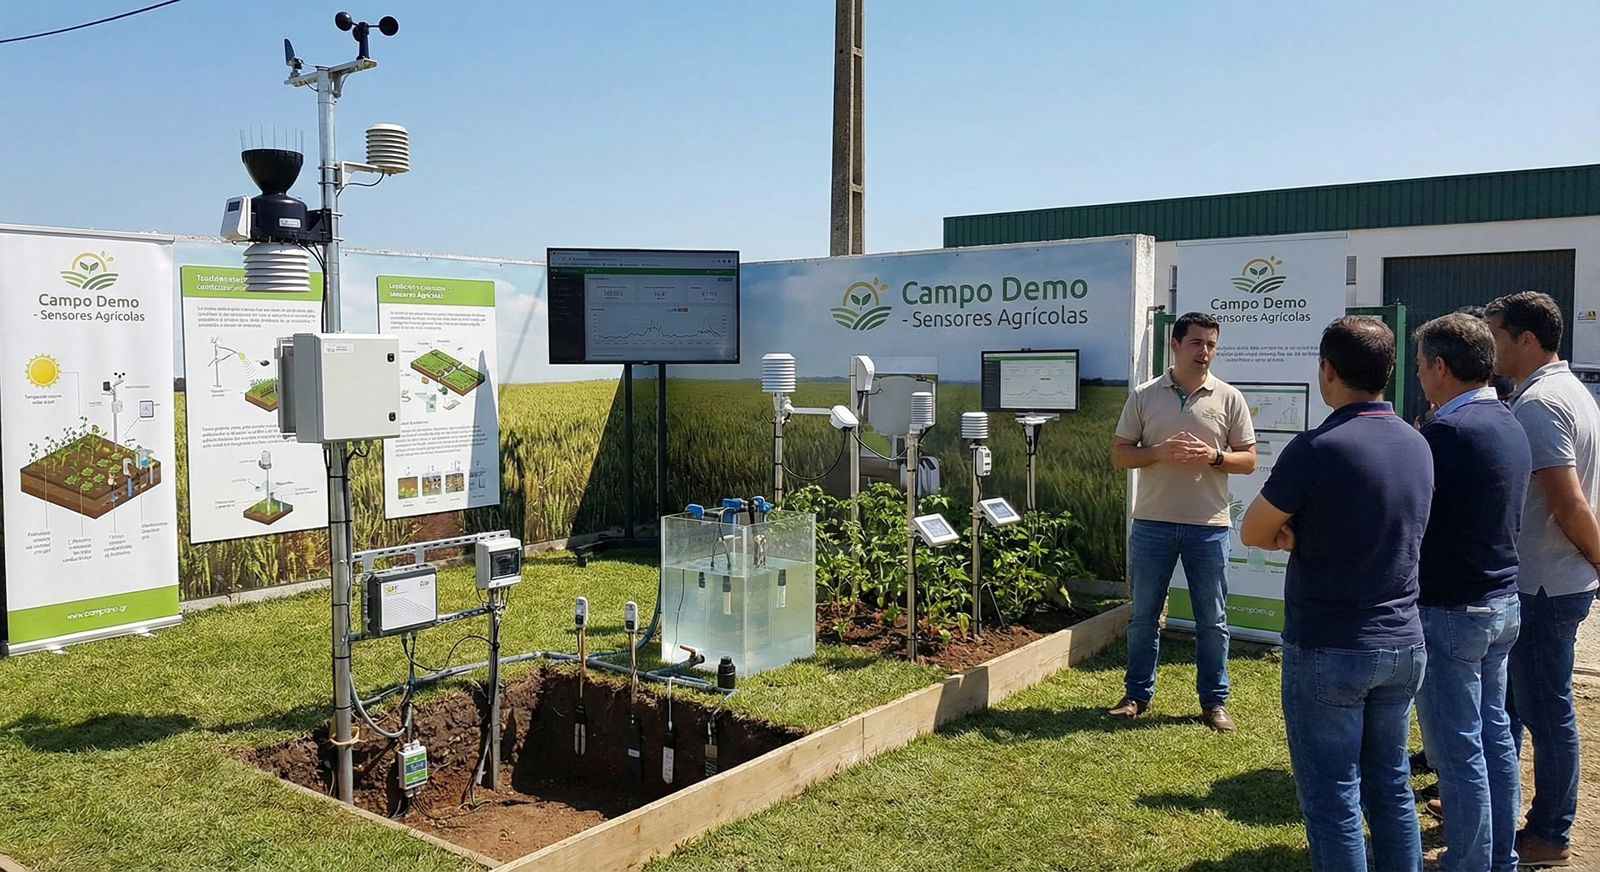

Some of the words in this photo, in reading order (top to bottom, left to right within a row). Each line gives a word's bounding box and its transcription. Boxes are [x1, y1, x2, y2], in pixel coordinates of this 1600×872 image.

[902, 281, 993, 309] Campo
[1002, 277, 1088, 302] Demo
[38, 293, 93, 309] Campo
[96, 295, 140, 308] Demo
[1210, 298, 1259, 312] Campo
[1263, 297, 1307, 309] Demo
[40, 309, 93, 321] Sensores
[95, 311, 145, 323] Agrícolas
[912, 311, 993, 328] Sensores
[997, 305, 1089, 330] Agrícolas
[1211, 313, 1258, 323] Sensores
[1260, 311, 1311, 324] Agrícolas
